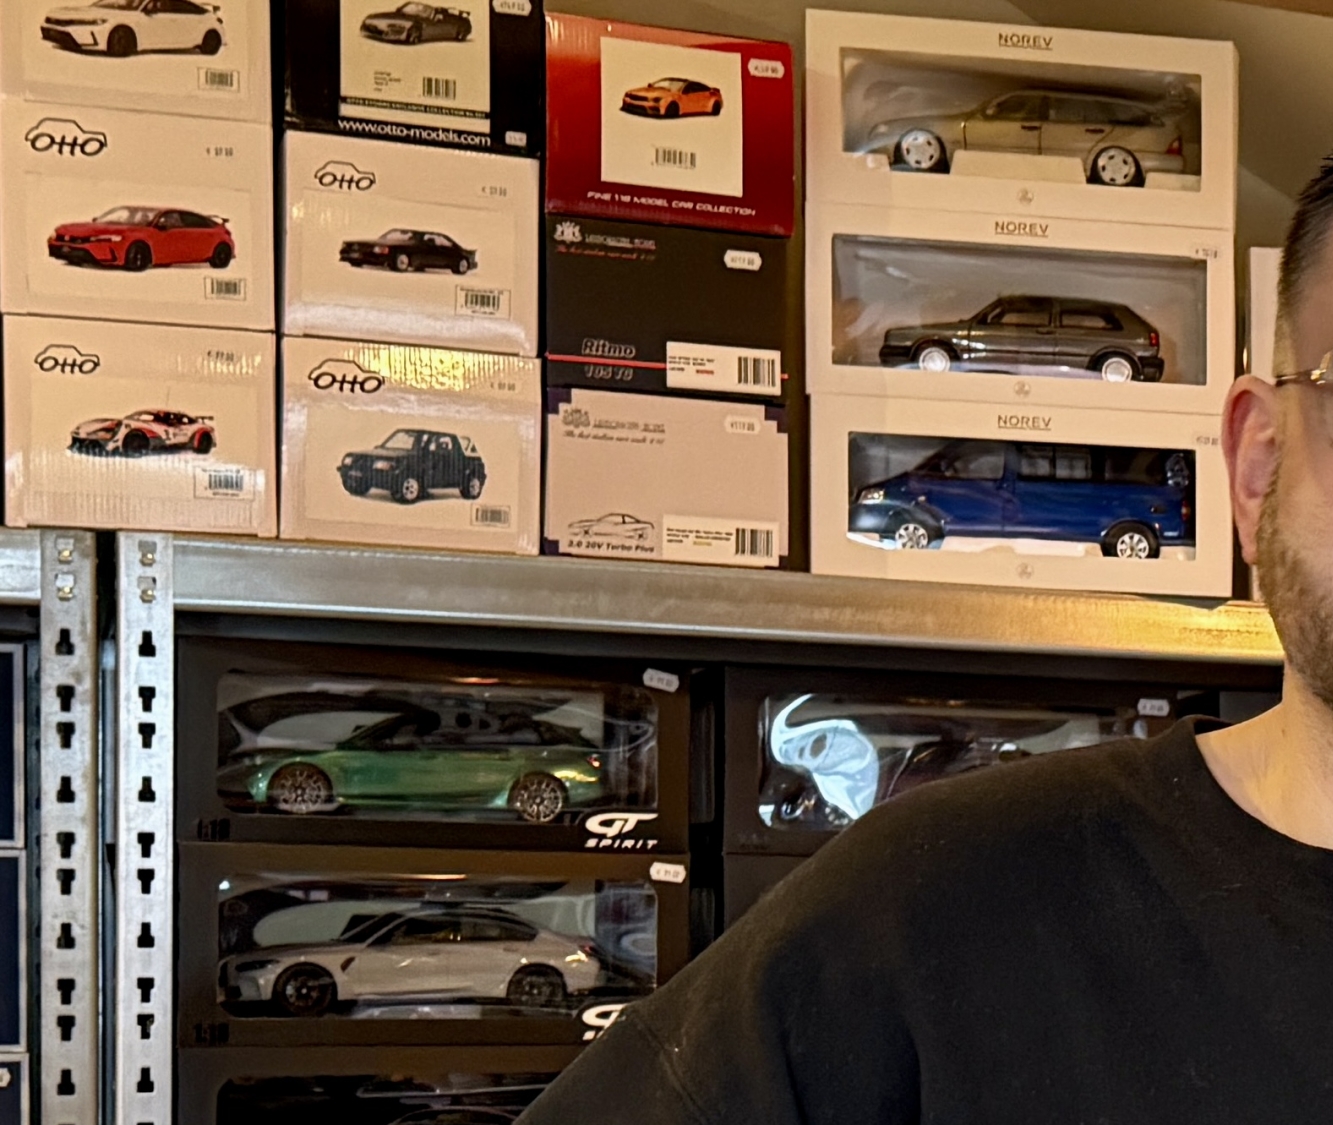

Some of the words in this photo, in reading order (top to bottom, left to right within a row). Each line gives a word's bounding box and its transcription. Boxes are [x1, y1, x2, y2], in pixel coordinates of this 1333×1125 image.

[998, 32, 1053, 51] NOREV
[337, 119, 491, 147] www.otto-models.com
[587, 191, 612, 201] FINE
[633, 195, 669, 208] MODEL
[672, 200, 694, 210] CAR
[696, 202, 756, 217] COLLECTION
[994, 221, 1049, 238] NOREV
[581, 337, 636, 359] Ritmo
[997, 414, 1052, 431] NOREV
[606, 543, 634, 552] Turbo
[635, 545, 655, 553] Plus
[585, 813, 659, 837] GT
[584, 838, 658, 849] SPIRIT
